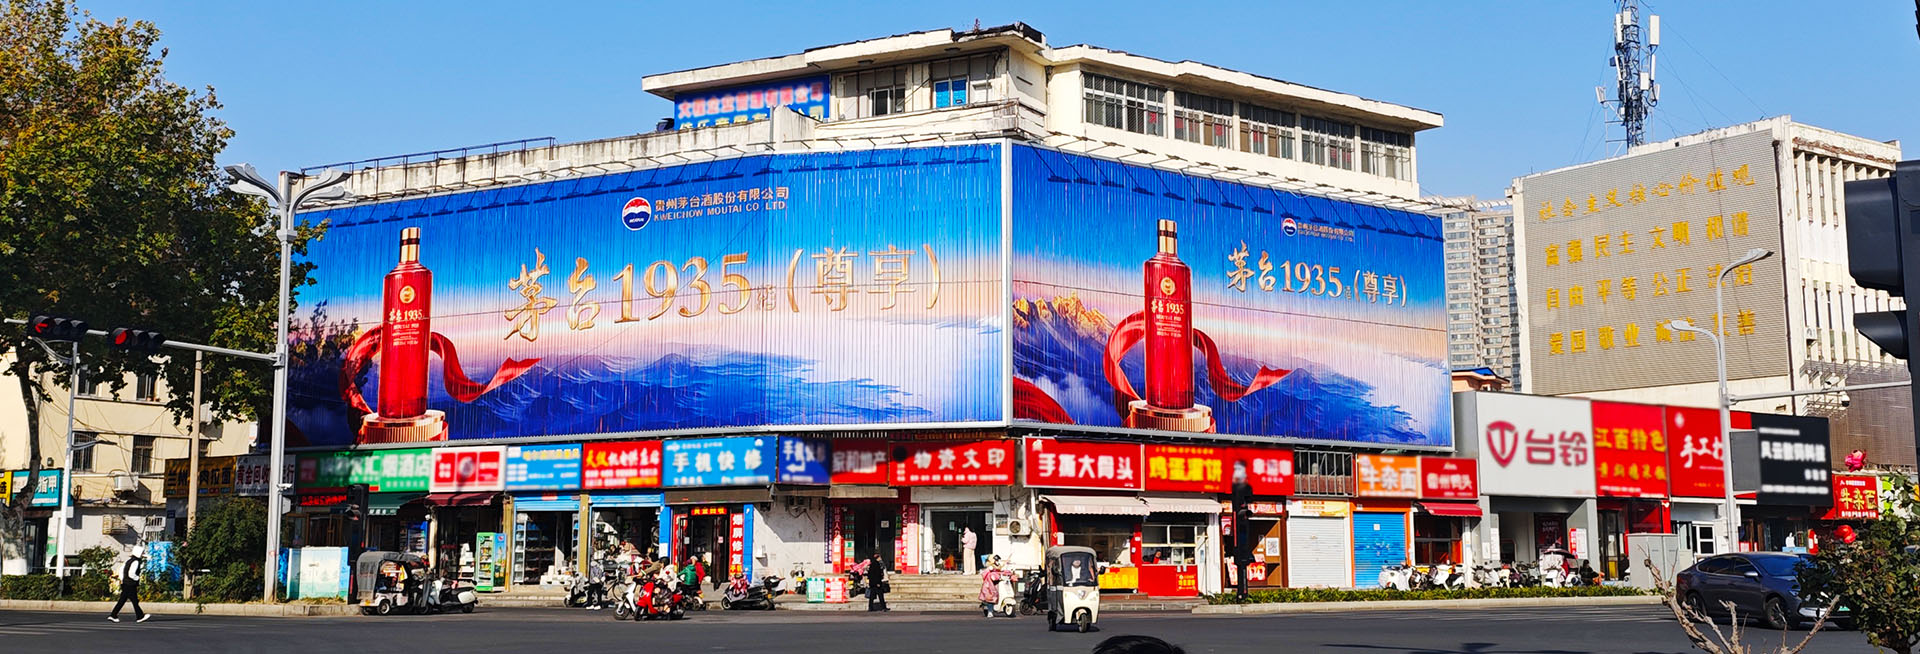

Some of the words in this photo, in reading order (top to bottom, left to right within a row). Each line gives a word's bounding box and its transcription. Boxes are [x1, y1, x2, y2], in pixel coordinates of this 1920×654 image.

[655, 187, 789, 212] 贵州茅台酒股份有限公司
[1538, 164, 1754, 222] 社会主义核心价值观
[654, 208, 703, 222] KWEICHOW
[706, 204, 742, 217] MOUTAI
[1545, 239, 1583, 266] 富强
[1594, 231, 1635, 258] 民主
[1649, 220, 1690, 250] 文明
[1706, 211, 1749, 241] 和谐
[1545, 285, 1584, 311] 自由
[1596, 277, 1638, 304] 平等
[1652, 268, 1692, 298] 公正
[1549, 329, 1586, 356] 爱国
[1598, 323, 1640, 350] 敬业
[1525, 428, 1589, 467] 台铃
[1596, 427, 1668, 453] 江西特色
[167, 466, 232, 488] 兰州肉拉面
